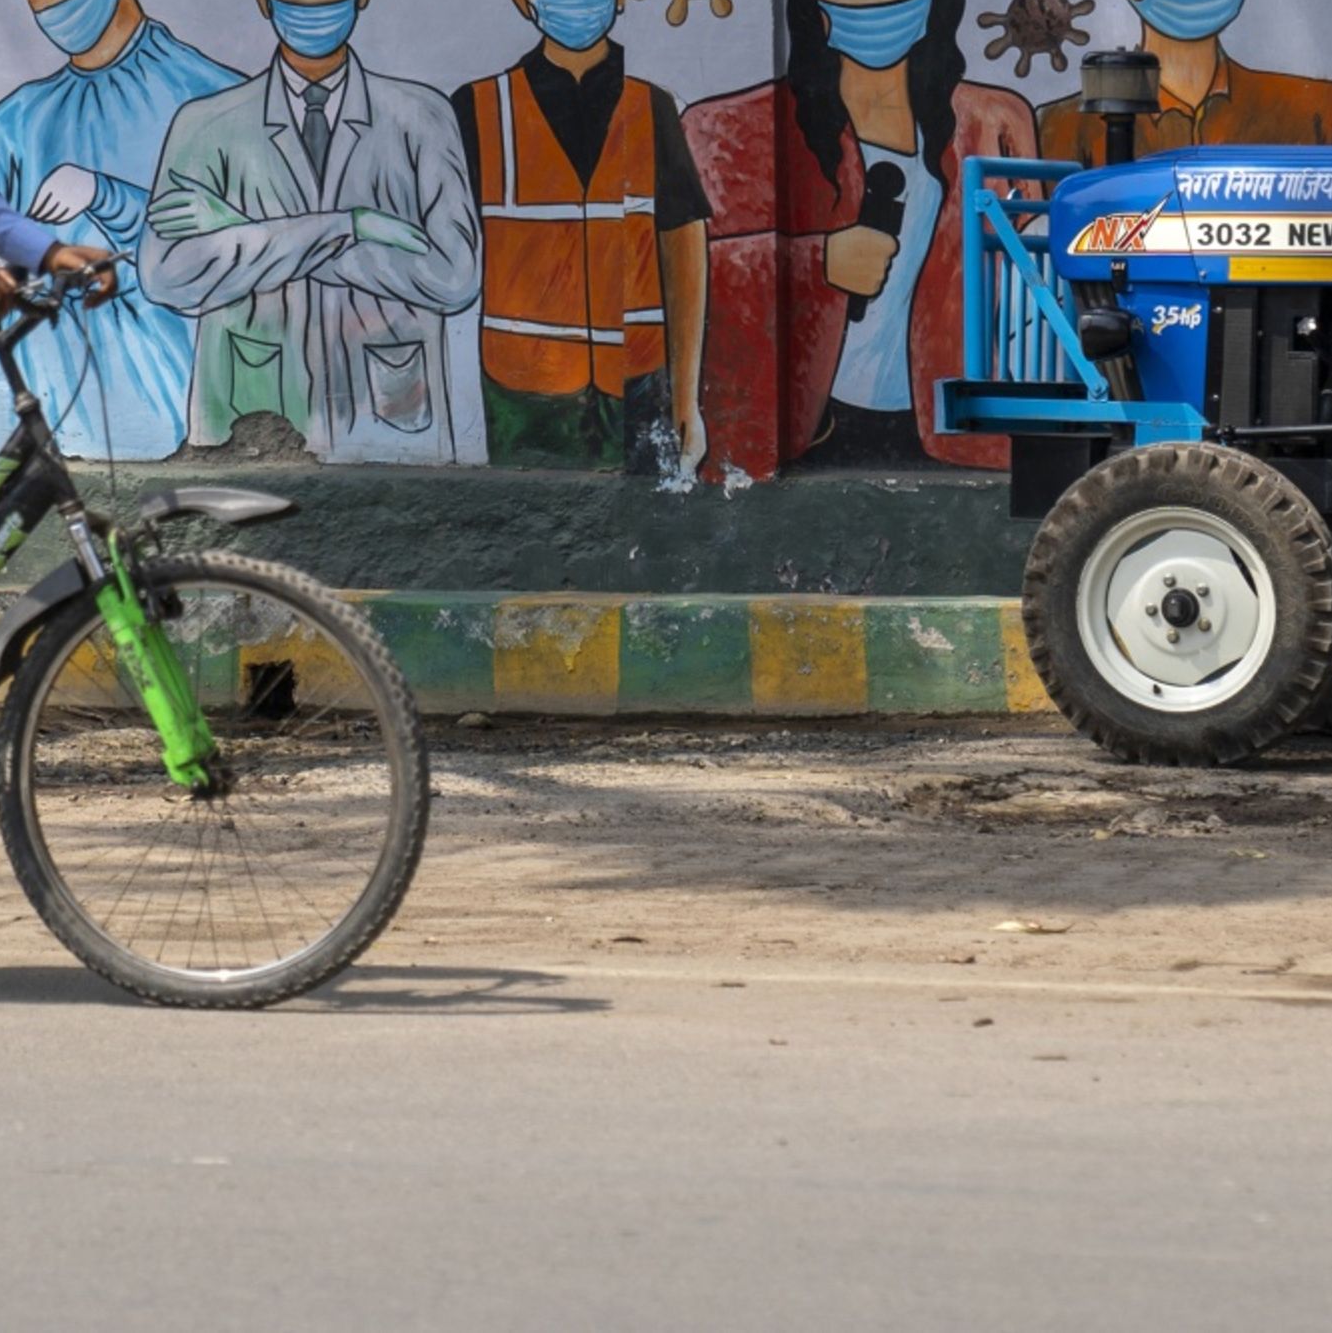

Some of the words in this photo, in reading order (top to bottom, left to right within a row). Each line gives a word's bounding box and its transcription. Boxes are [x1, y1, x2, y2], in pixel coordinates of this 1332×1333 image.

[1177, 171, 1223, 200] नगर
[1225, 169, 1277, 201] निगम
[1197, 223, 1271, 246] 3032
